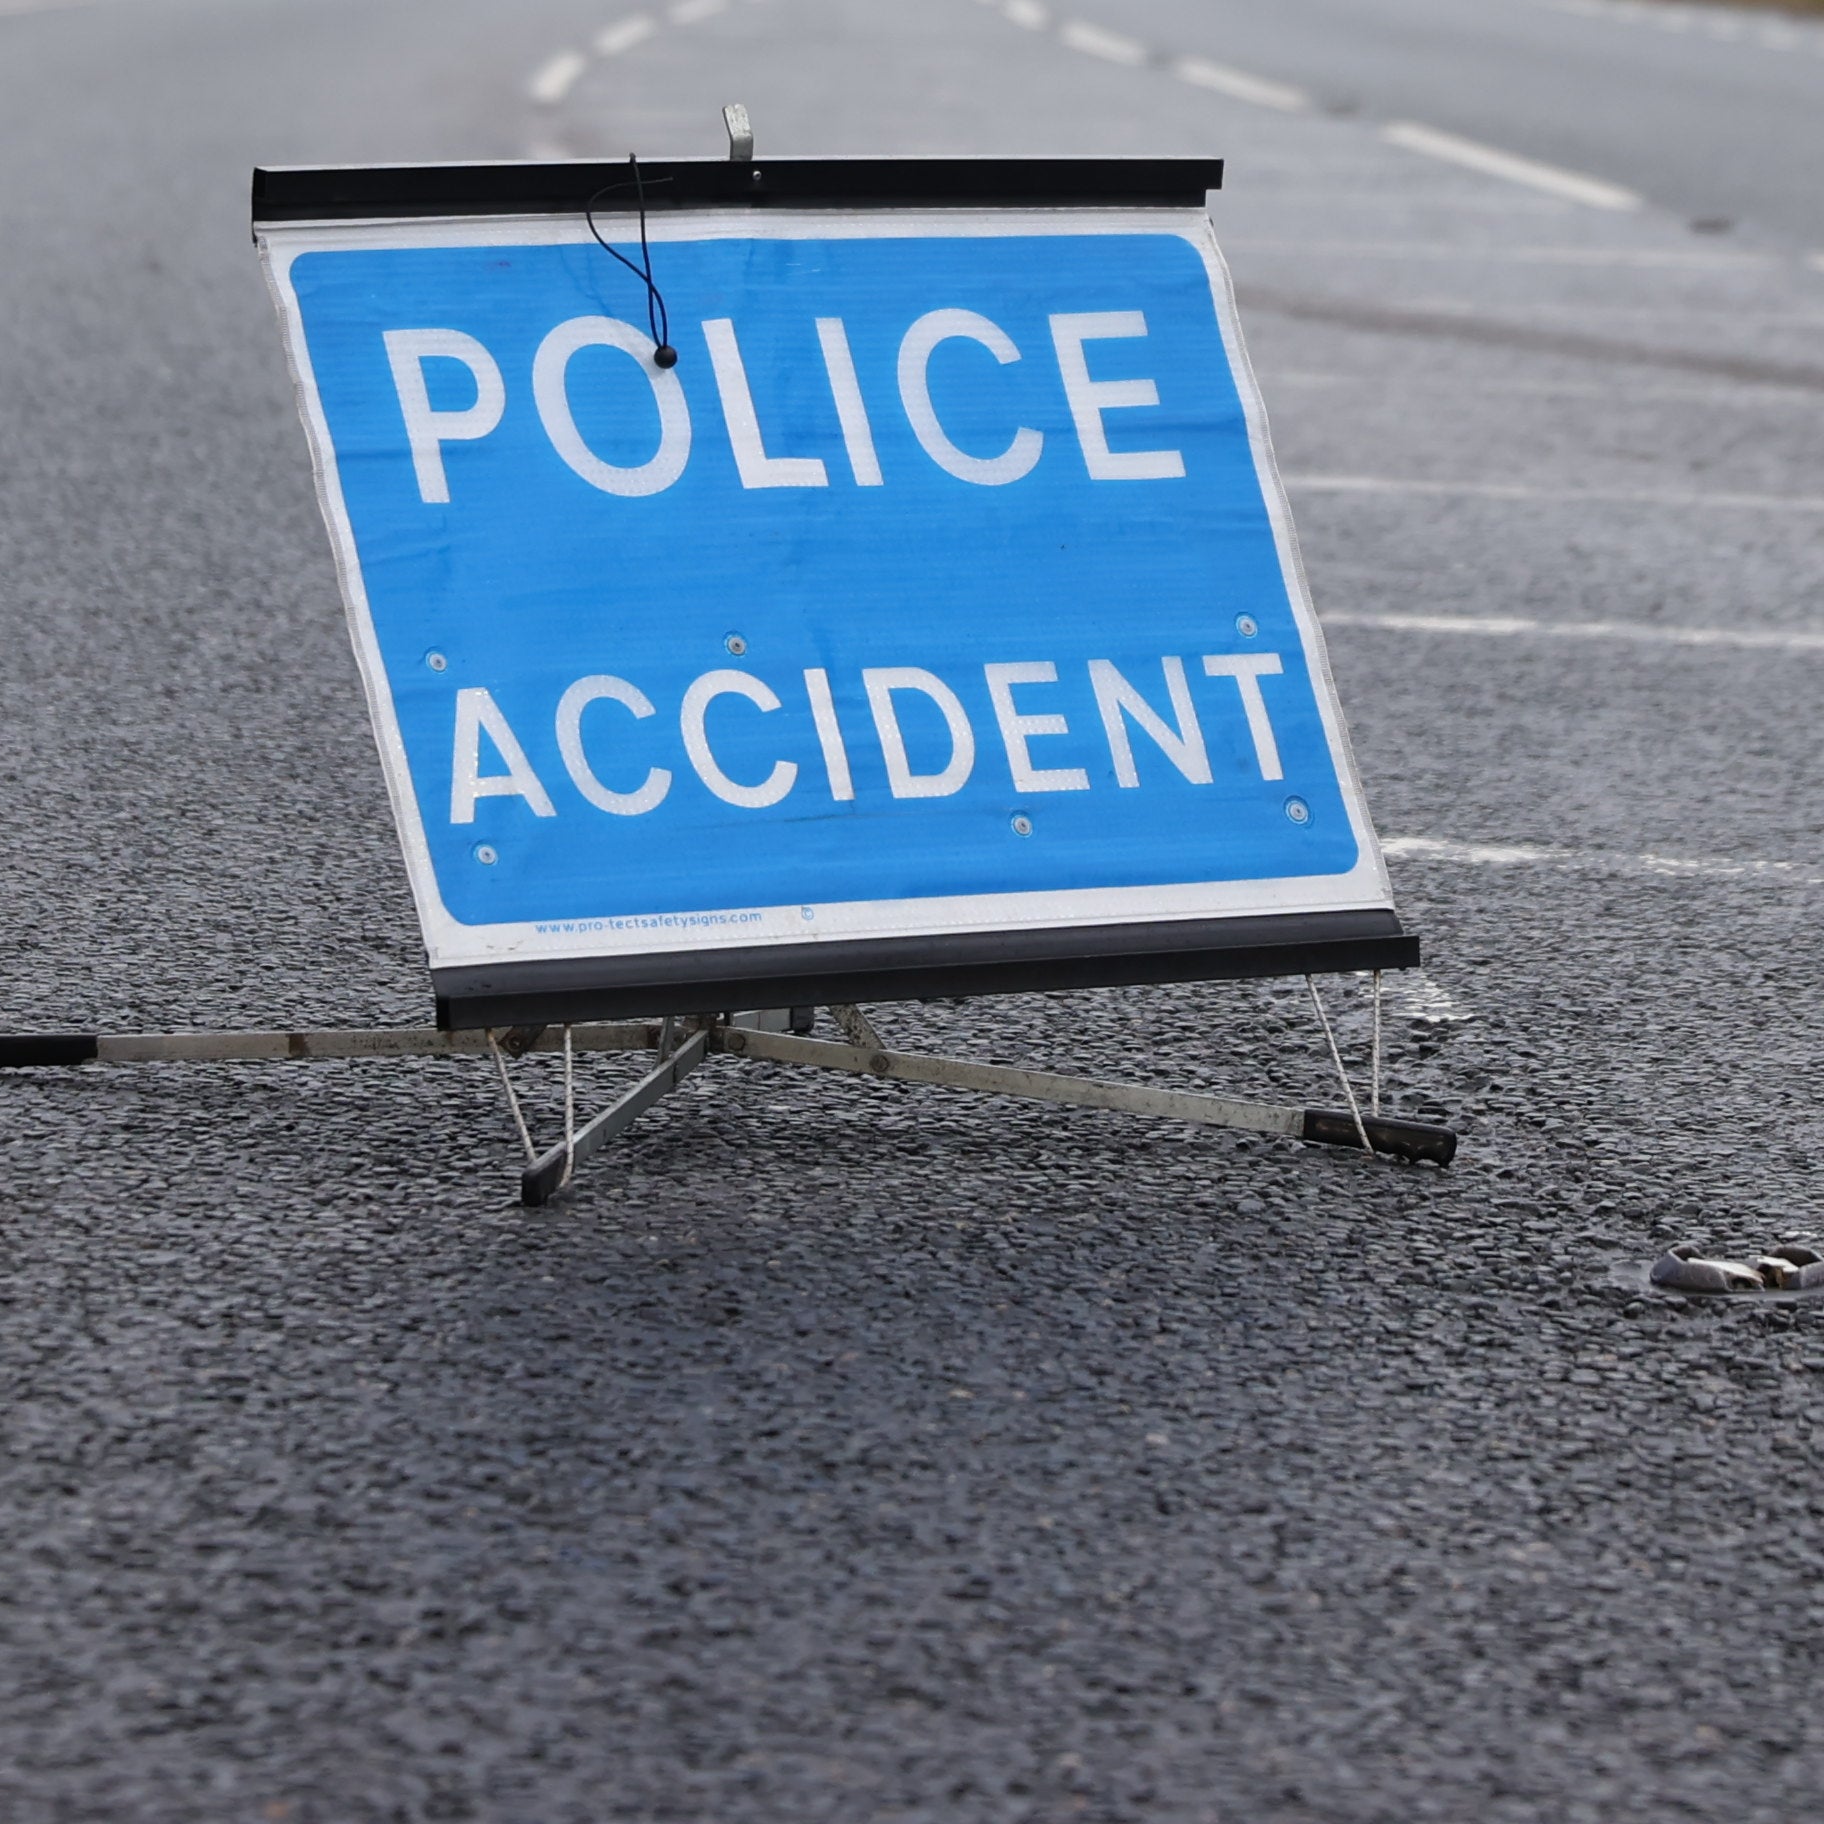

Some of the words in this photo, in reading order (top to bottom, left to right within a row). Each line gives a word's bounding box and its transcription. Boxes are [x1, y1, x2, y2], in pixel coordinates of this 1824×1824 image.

[383, 307, 1186, 504] POLICE
[449, 652, 1285, 825] ACCIDENT
[535, 910, 763, 934] www.pro-tectsafetysigns.com
